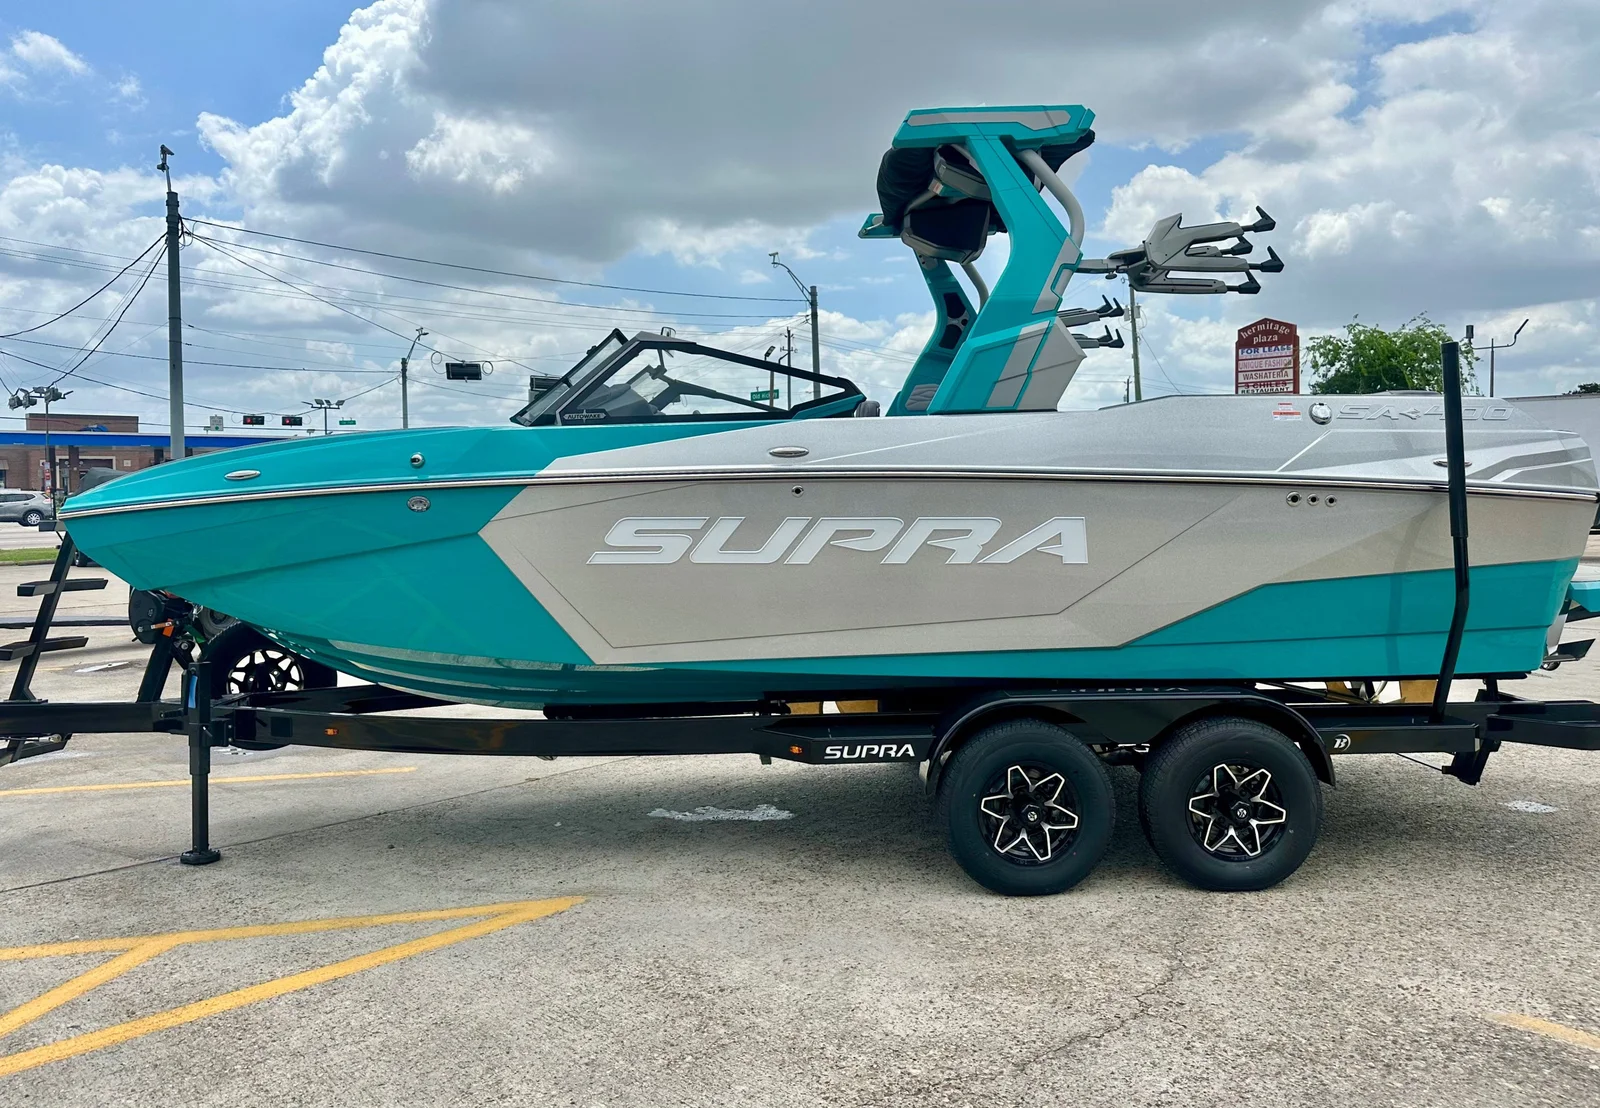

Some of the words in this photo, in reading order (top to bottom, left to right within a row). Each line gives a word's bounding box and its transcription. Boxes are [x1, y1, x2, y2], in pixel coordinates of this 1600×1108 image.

[1240, 321, 1290, 339] hermitage
[1253, 334, 1278, 344] plaza
[1262, 345, 1292, 353] LEASE
[1239, 359, 1263, 369] UNIQUE
[1243, 370, 1289, 380] WASHATERIA
[586, 516, 1089, 565] SUPRA
[823, 743, 915, 759] SUPRA
